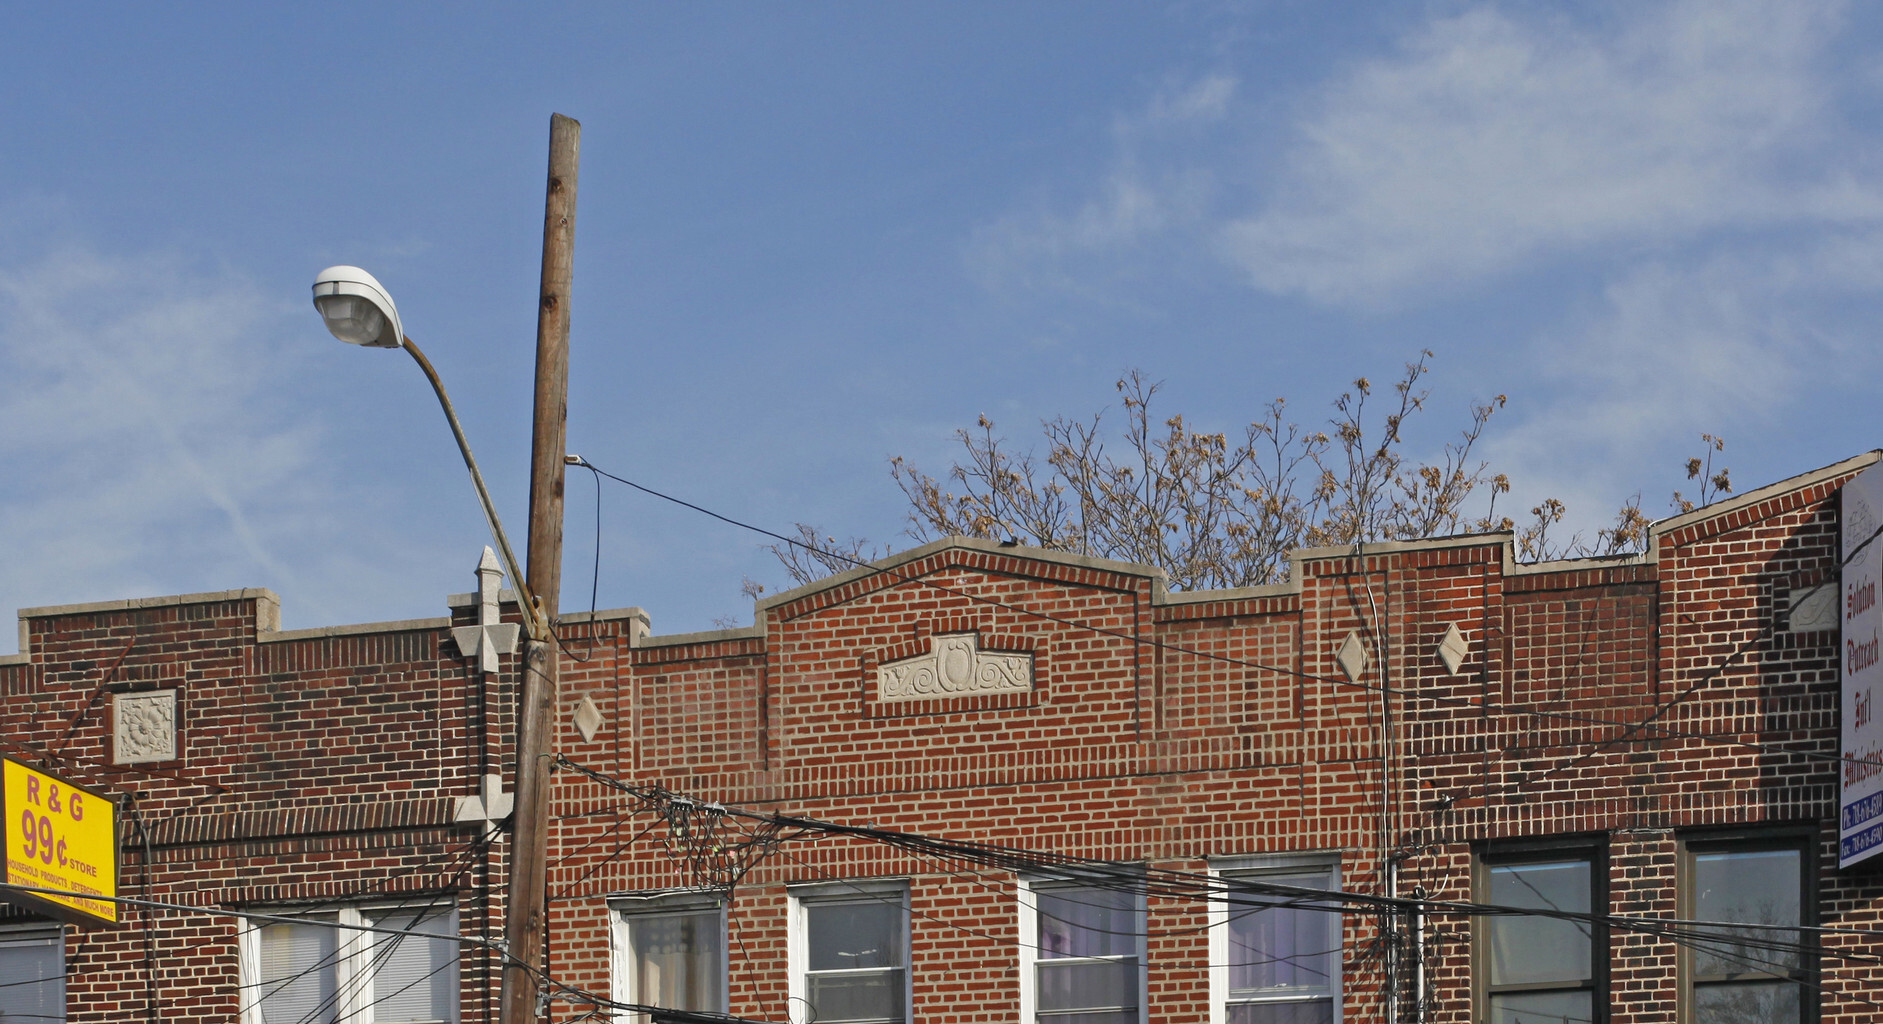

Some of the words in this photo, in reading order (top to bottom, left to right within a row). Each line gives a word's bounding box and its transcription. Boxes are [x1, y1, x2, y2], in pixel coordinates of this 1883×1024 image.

[1847, 574, 1876, 624] Solution
[1846, 626, 1879, 677] Outreach
[27, 774, 41, 806] R
[48, 784, 62, 814] &
[70, 793, 83, 822] G
[70, 859, 97, 878] STORE
[100, 904, 114, 917] MORE
